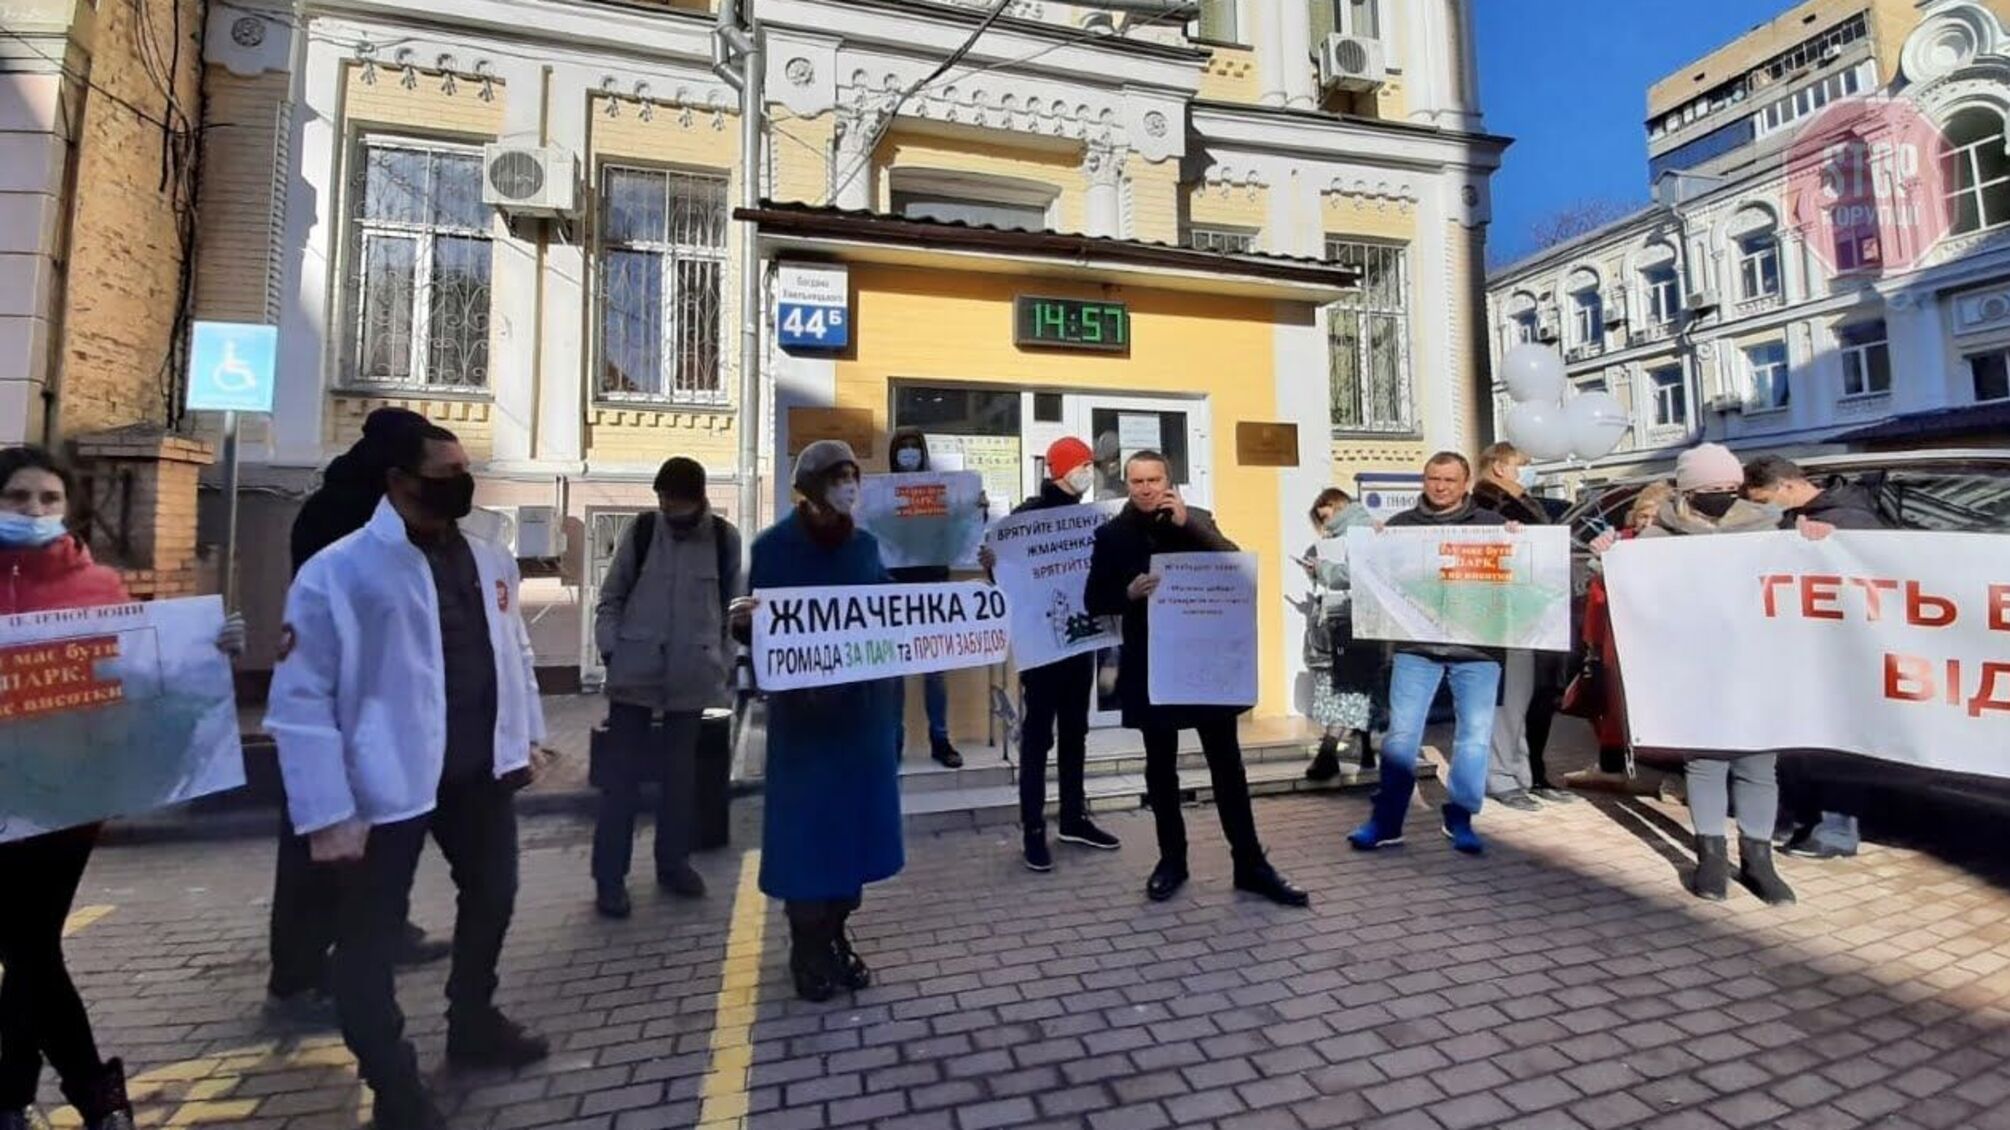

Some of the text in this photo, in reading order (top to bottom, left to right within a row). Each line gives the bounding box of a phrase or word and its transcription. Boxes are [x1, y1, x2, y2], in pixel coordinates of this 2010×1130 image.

[1035, 303, 1123, 343] 14:57
[998, 520, 1054, 541] ВРЯТУЙТЕ
[769, 590, 1006, 636] ЖМАЧЕНКА 20
[1759, 574, 1958, 628] ГЕТЬ
[767, 643, 842, 678] ГРОМАДА
[846, 639, 862, 666] ЗА
[914, 633, 954, 660] ПРОТИ
[956, 629, 1007, 656] ЗАБУДОВ
